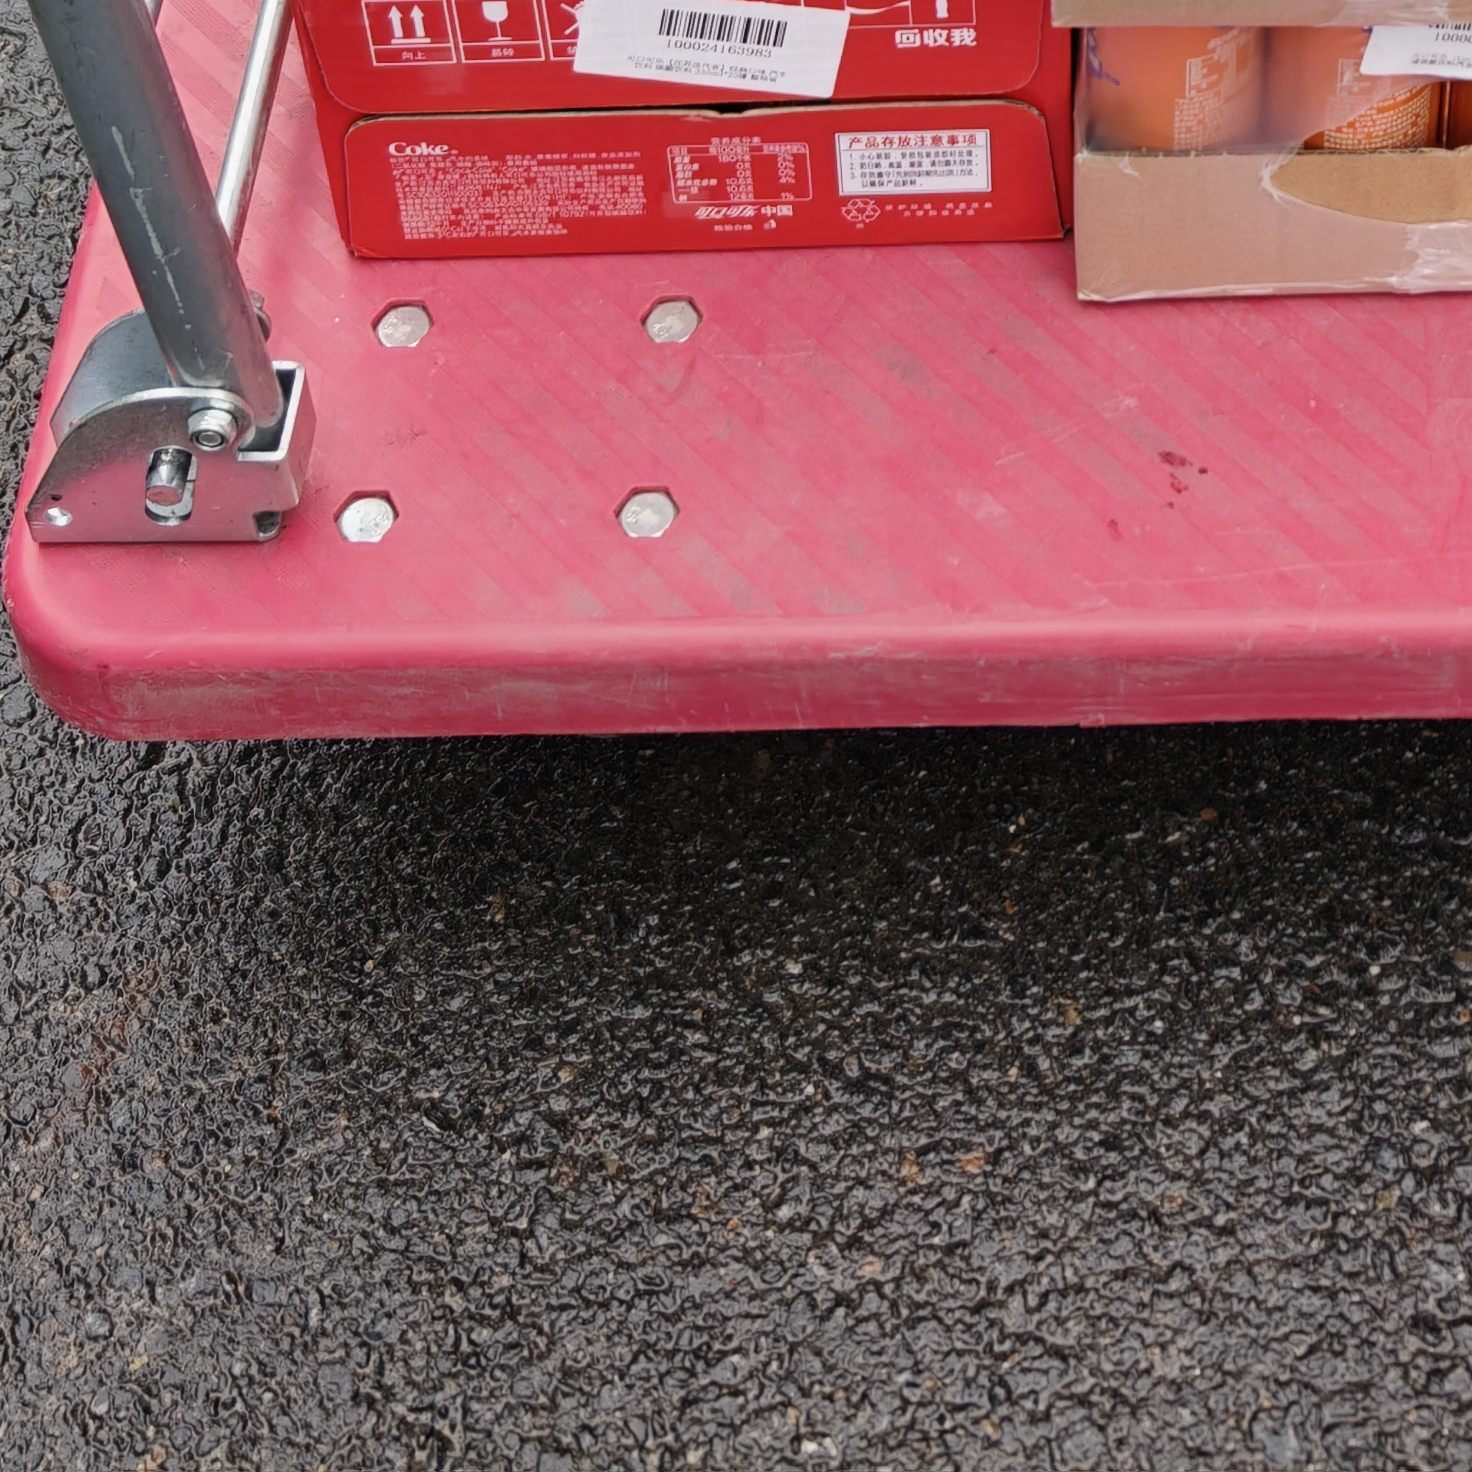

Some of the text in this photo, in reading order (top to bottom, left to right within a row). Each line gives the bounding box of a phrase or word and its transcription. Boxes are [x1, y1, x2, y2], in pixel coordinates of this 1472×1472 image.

[893, 26, 979, 50] 回收我
[666, 38, 773, 59] 100024163983
[388, 141, 449, 157] Coke
[848, 133, 978, 149] 产品存放注意事项
